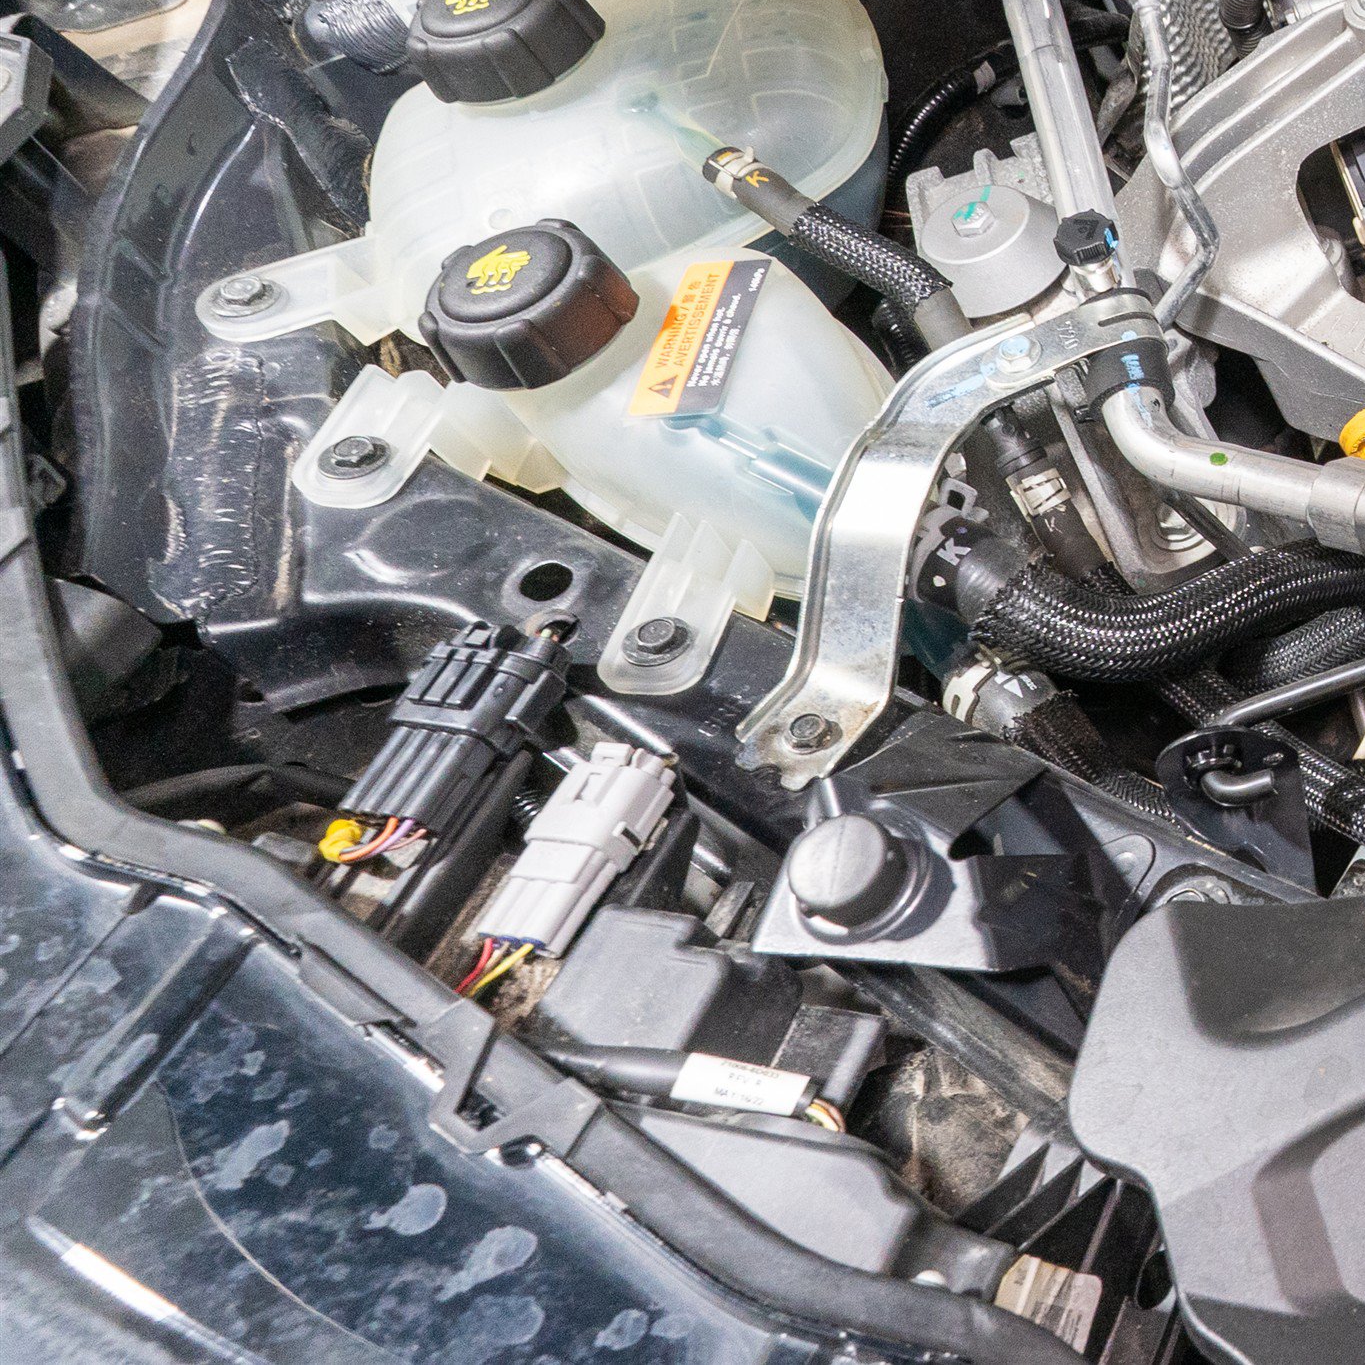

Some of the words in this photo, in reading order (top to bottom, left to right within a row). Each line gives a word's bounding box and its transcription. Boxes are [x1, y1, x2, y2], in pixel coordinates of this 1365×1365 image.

[655, 312, 687, 367] WARNING
[672, 273, 720, 366] AVERTISSEMENT
[936, 537, 972, 566] K
